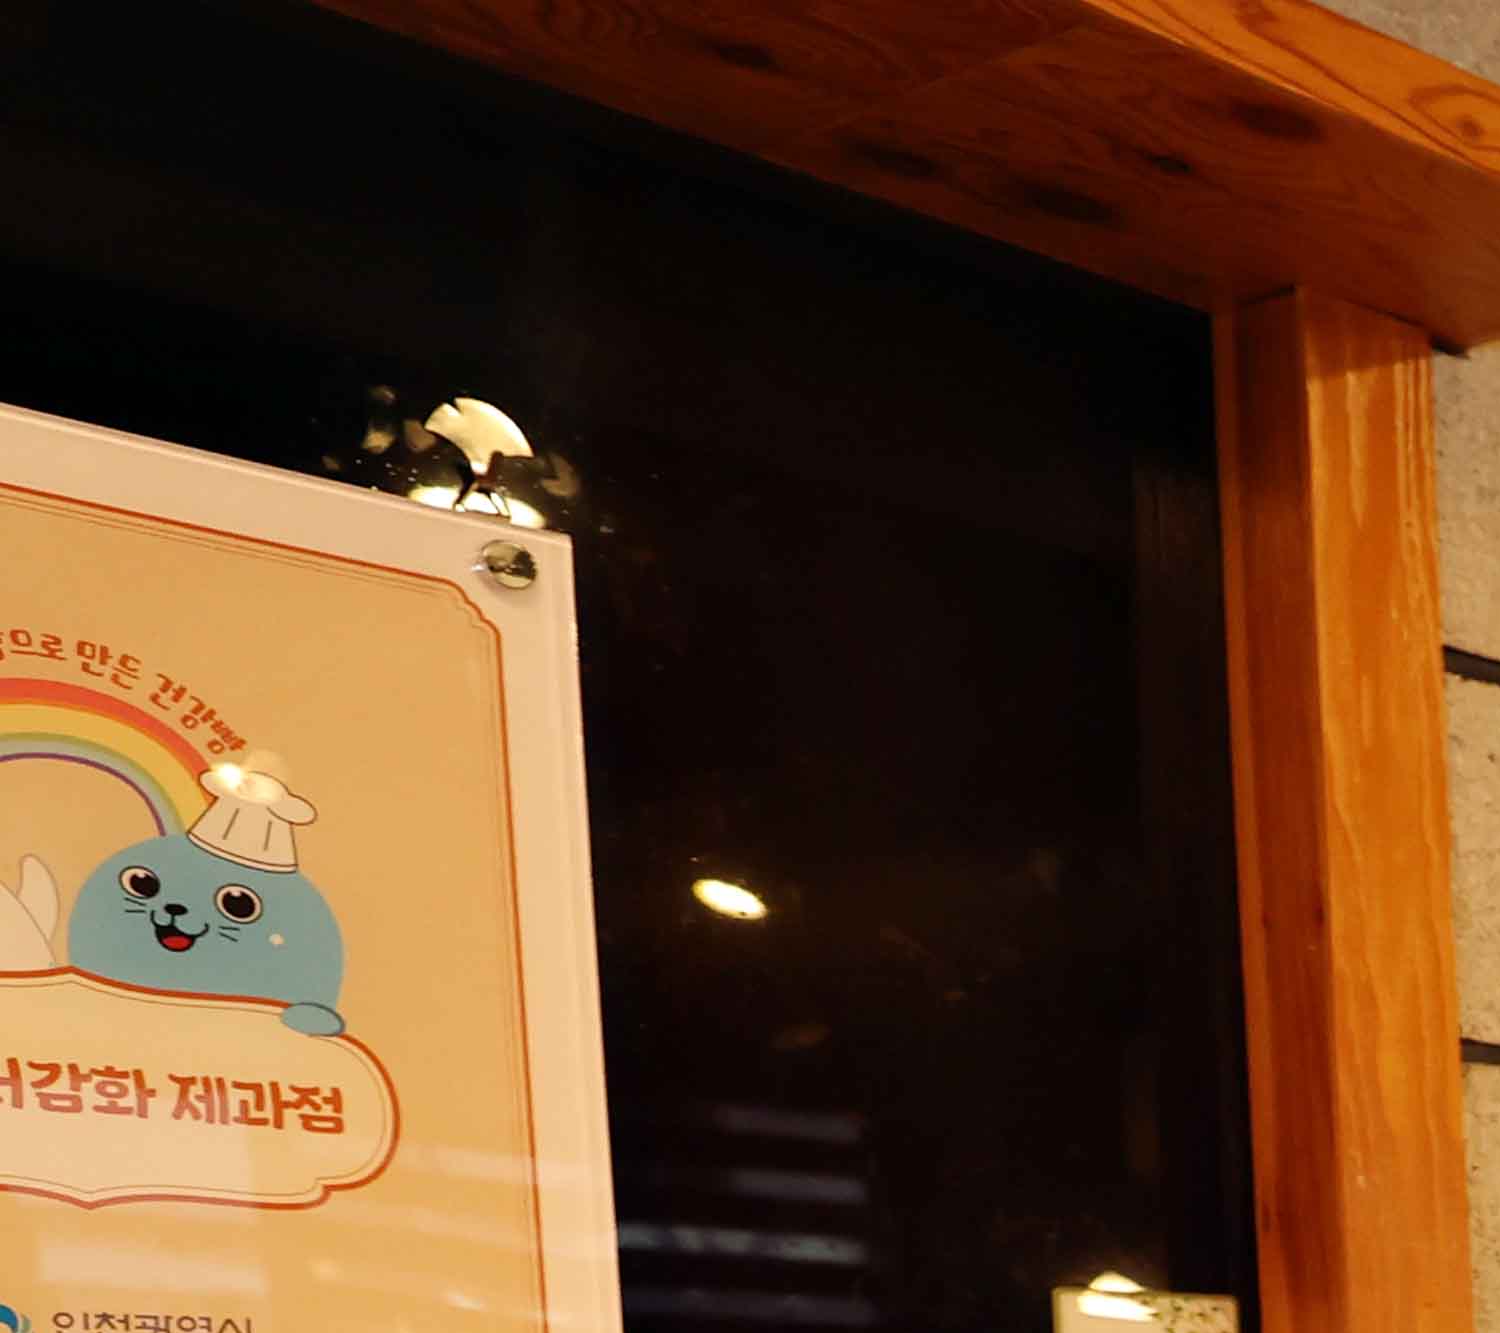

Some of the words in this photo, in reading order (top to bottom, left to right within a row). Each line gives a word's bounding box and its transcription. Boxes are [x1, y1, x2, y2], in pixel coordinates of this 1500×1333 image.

[0, 628, 67, 661] 으로
[76, 639, 143, 690] 만든
[149, 672, 248, 755] 건강빵
[168, 1073, 345, 1135] 제과점
